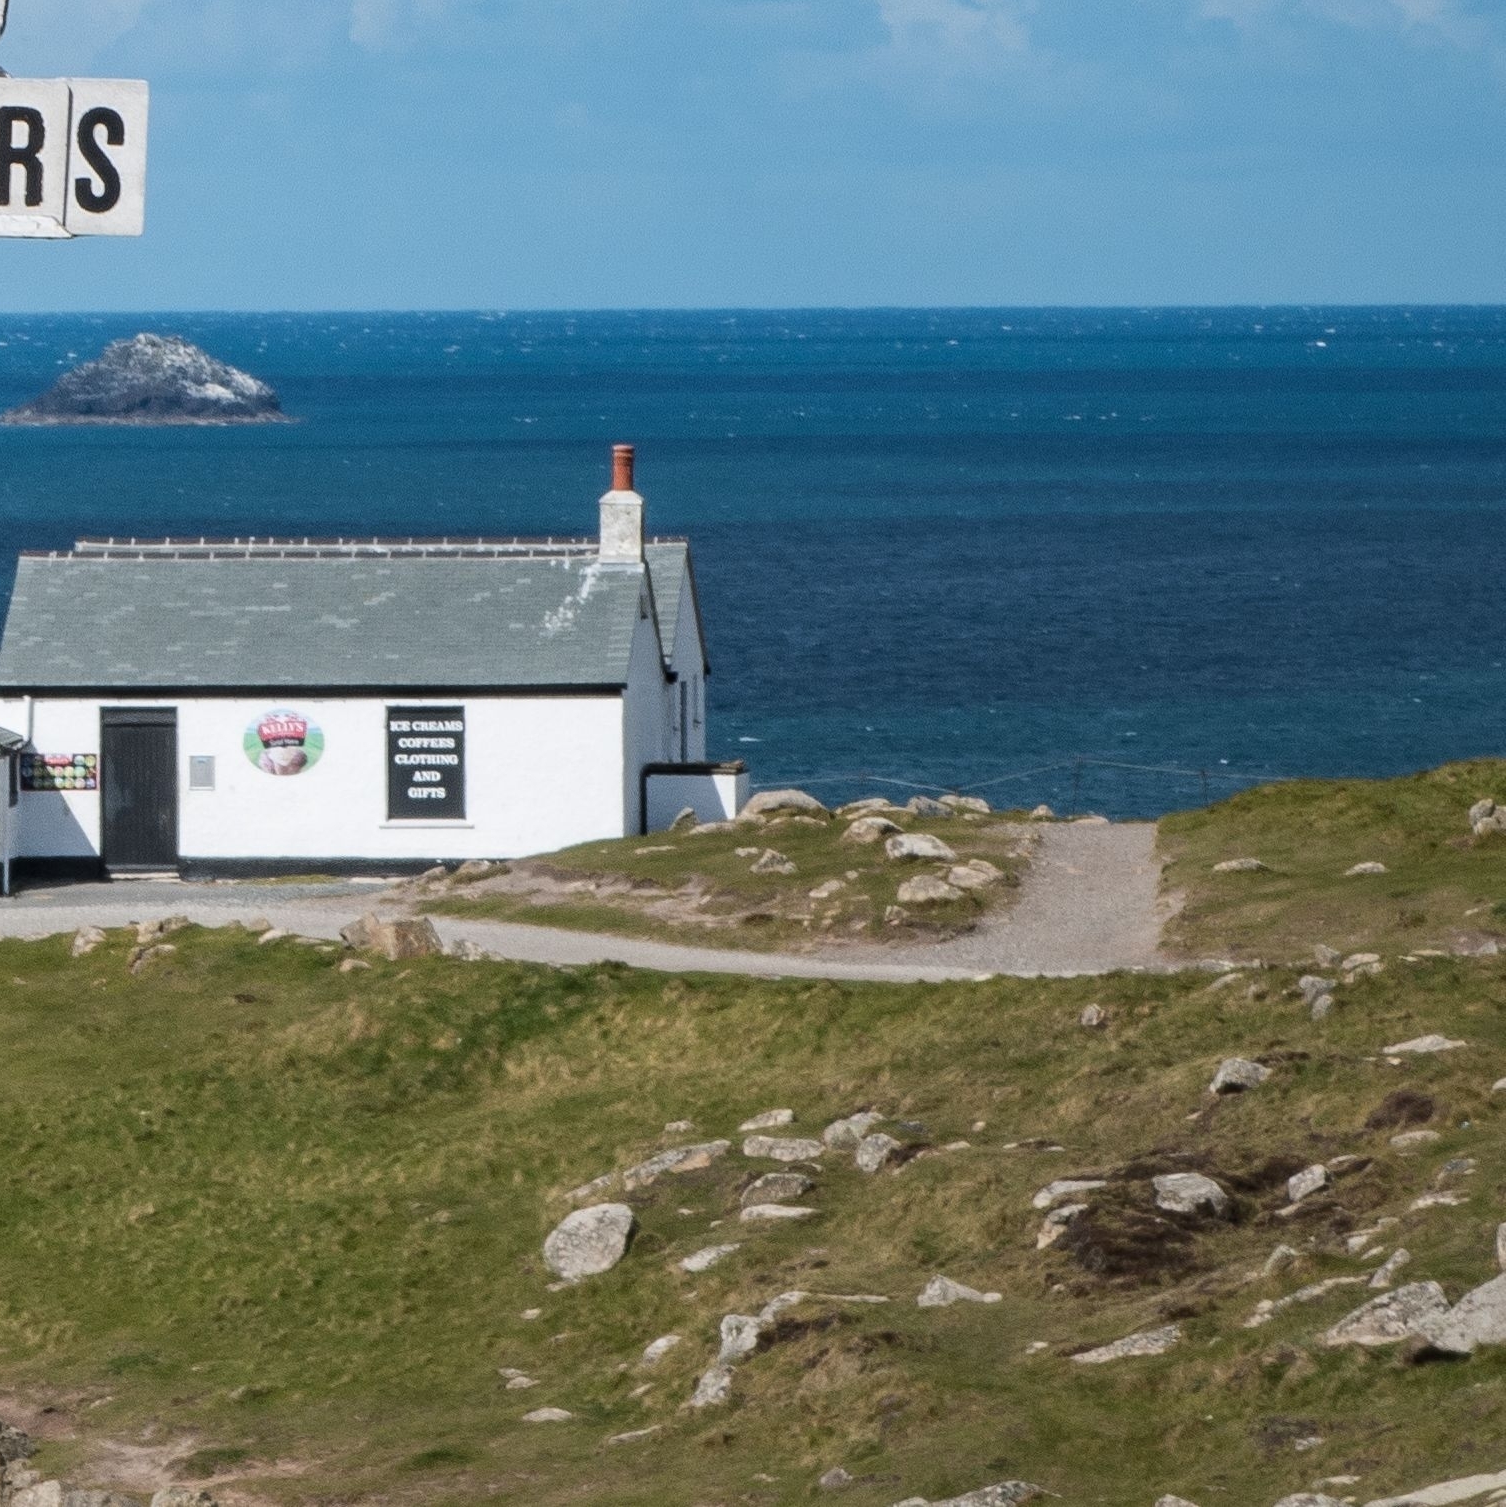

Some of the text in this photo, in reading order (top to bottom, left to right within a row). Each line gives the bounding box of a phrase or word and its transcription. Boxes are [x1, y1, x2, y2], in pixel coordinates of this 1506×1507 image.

[390, 721, 463, 732] ICE CREAMS
[397, 737, 455, 748] COFFEES
[394, 754, 458, 765] CLOTHING
[412, 771, 441, 782] AND
[407, 787, 446, 799] GIFTS
